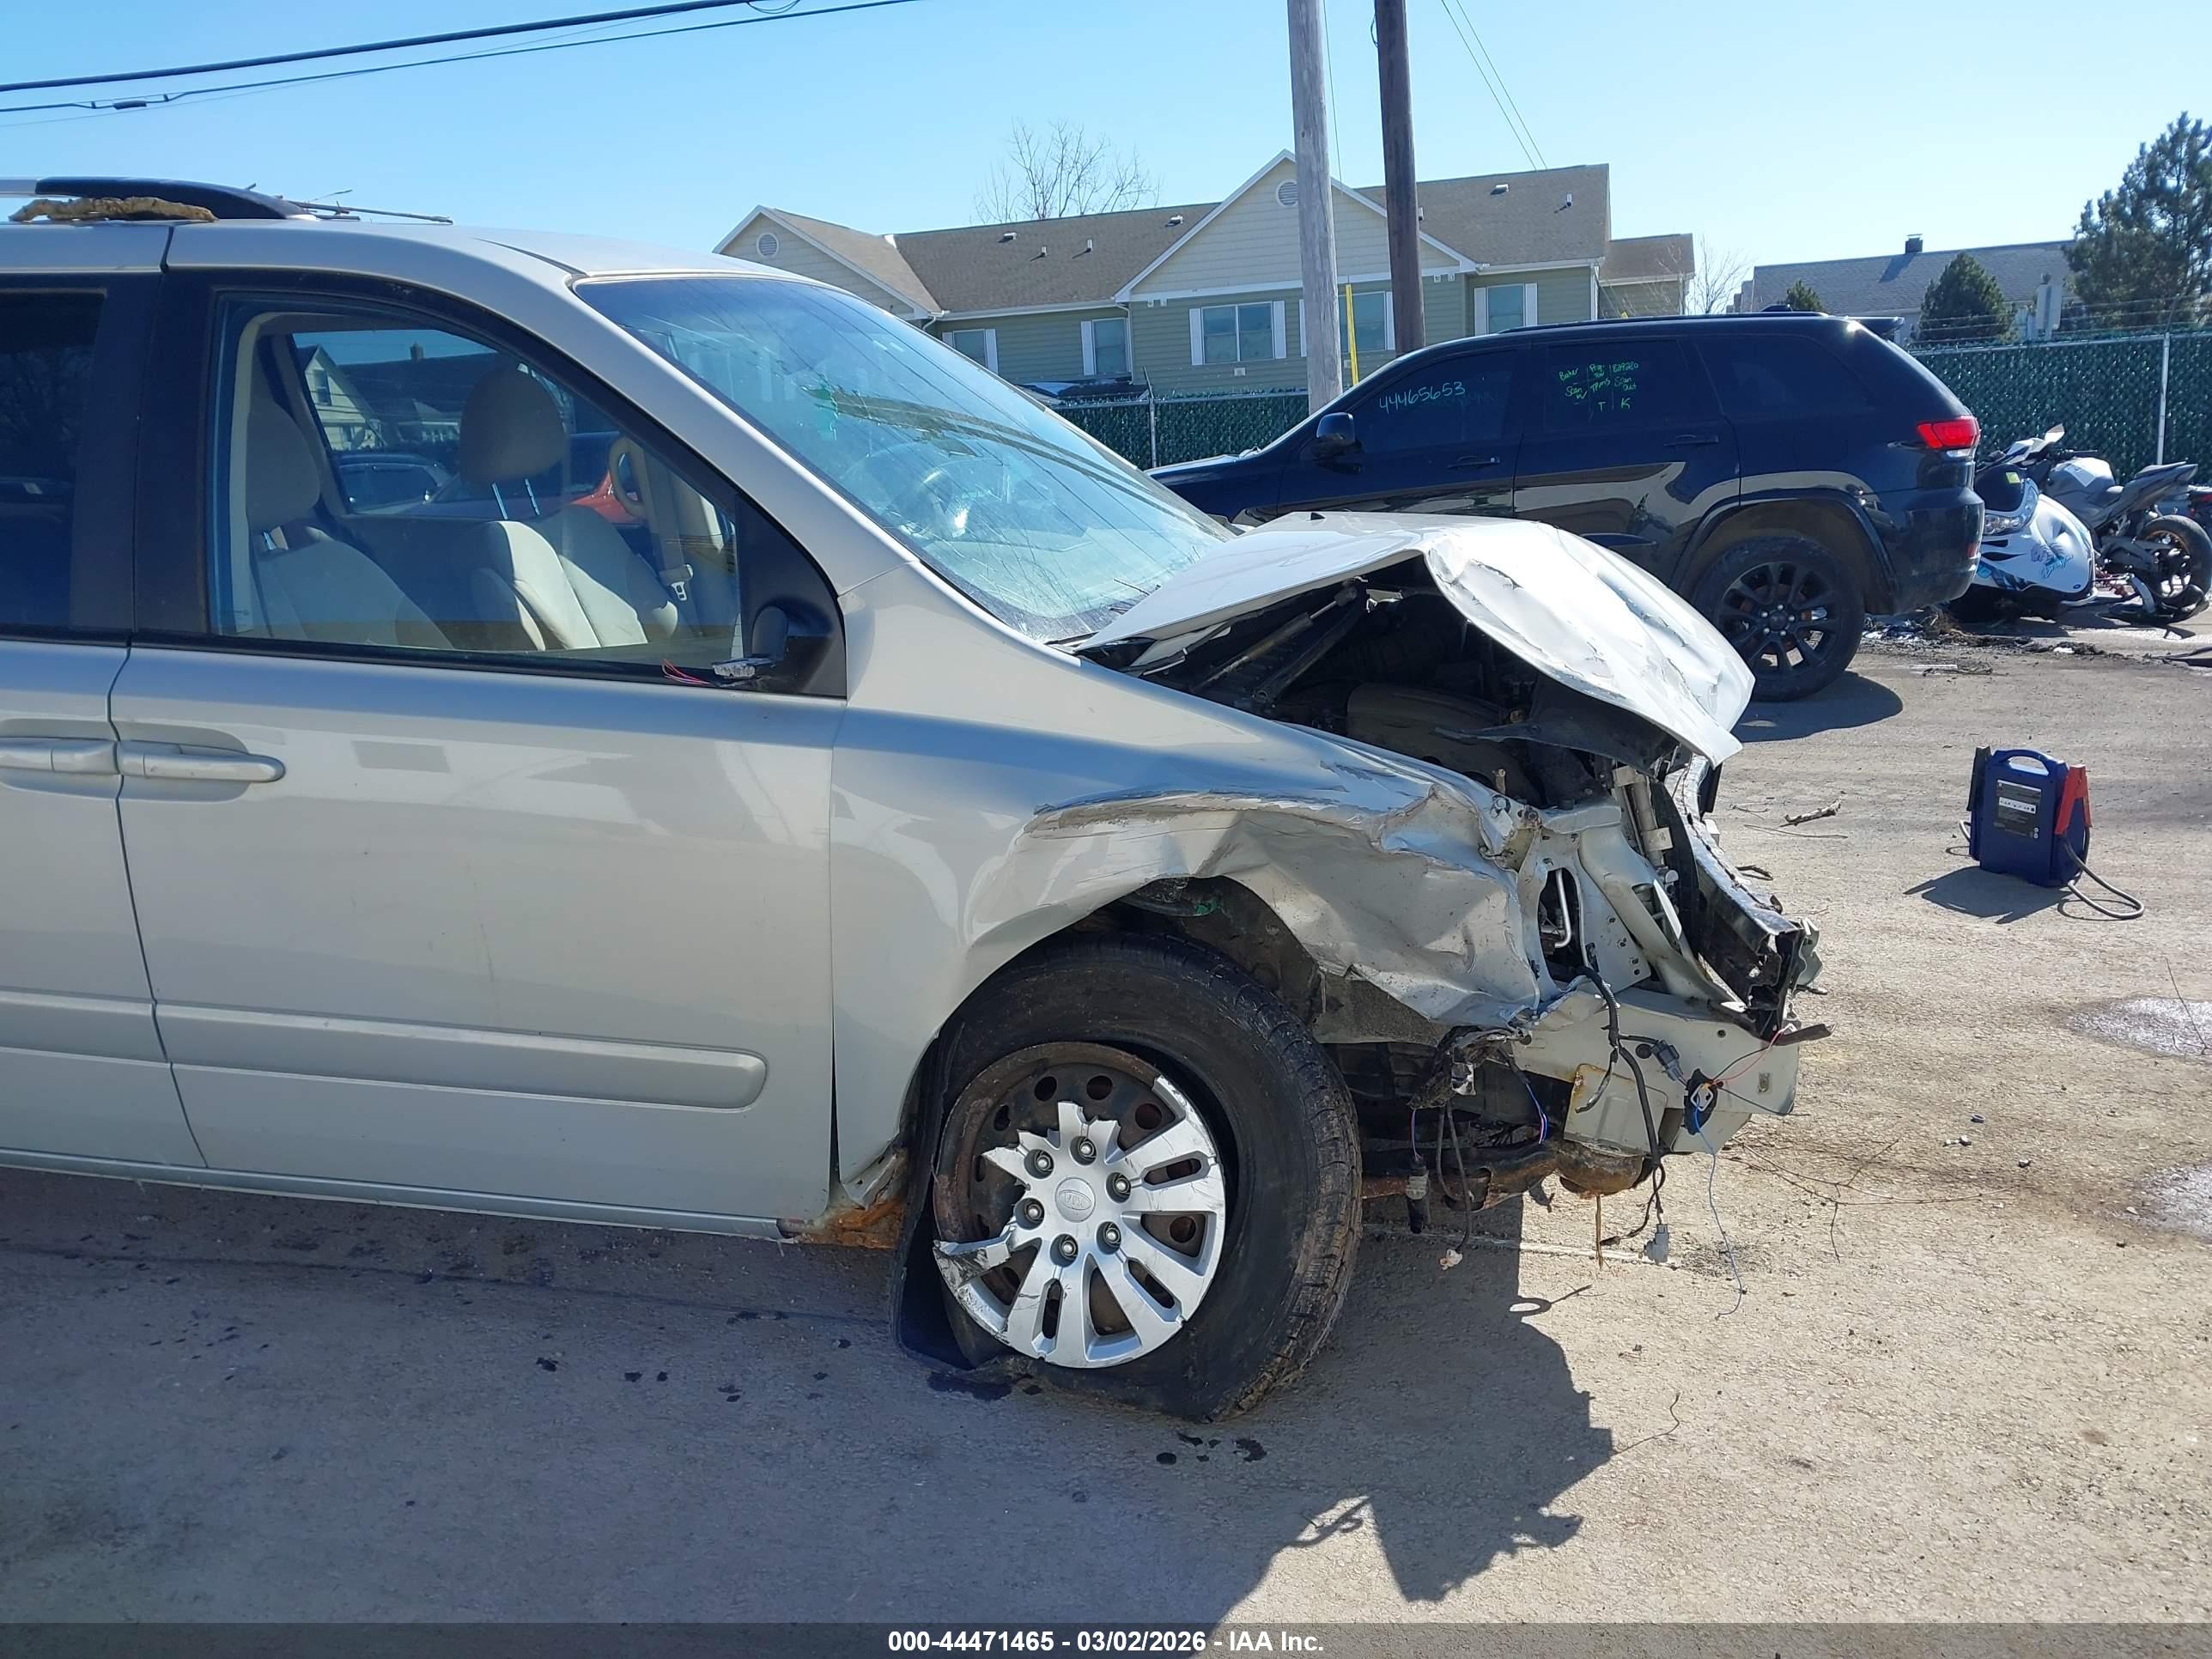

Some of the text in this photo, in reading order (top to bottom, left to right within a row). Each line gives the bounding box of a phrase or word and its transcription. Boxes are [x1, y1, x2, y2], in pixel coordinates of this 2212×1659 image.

[1565, 386, 1583, 397] Scan
[1379, 381, 1466, 414] 44465653
[1598, 402, 1607, 412] T
[1620, 398, 1631, 410] K
